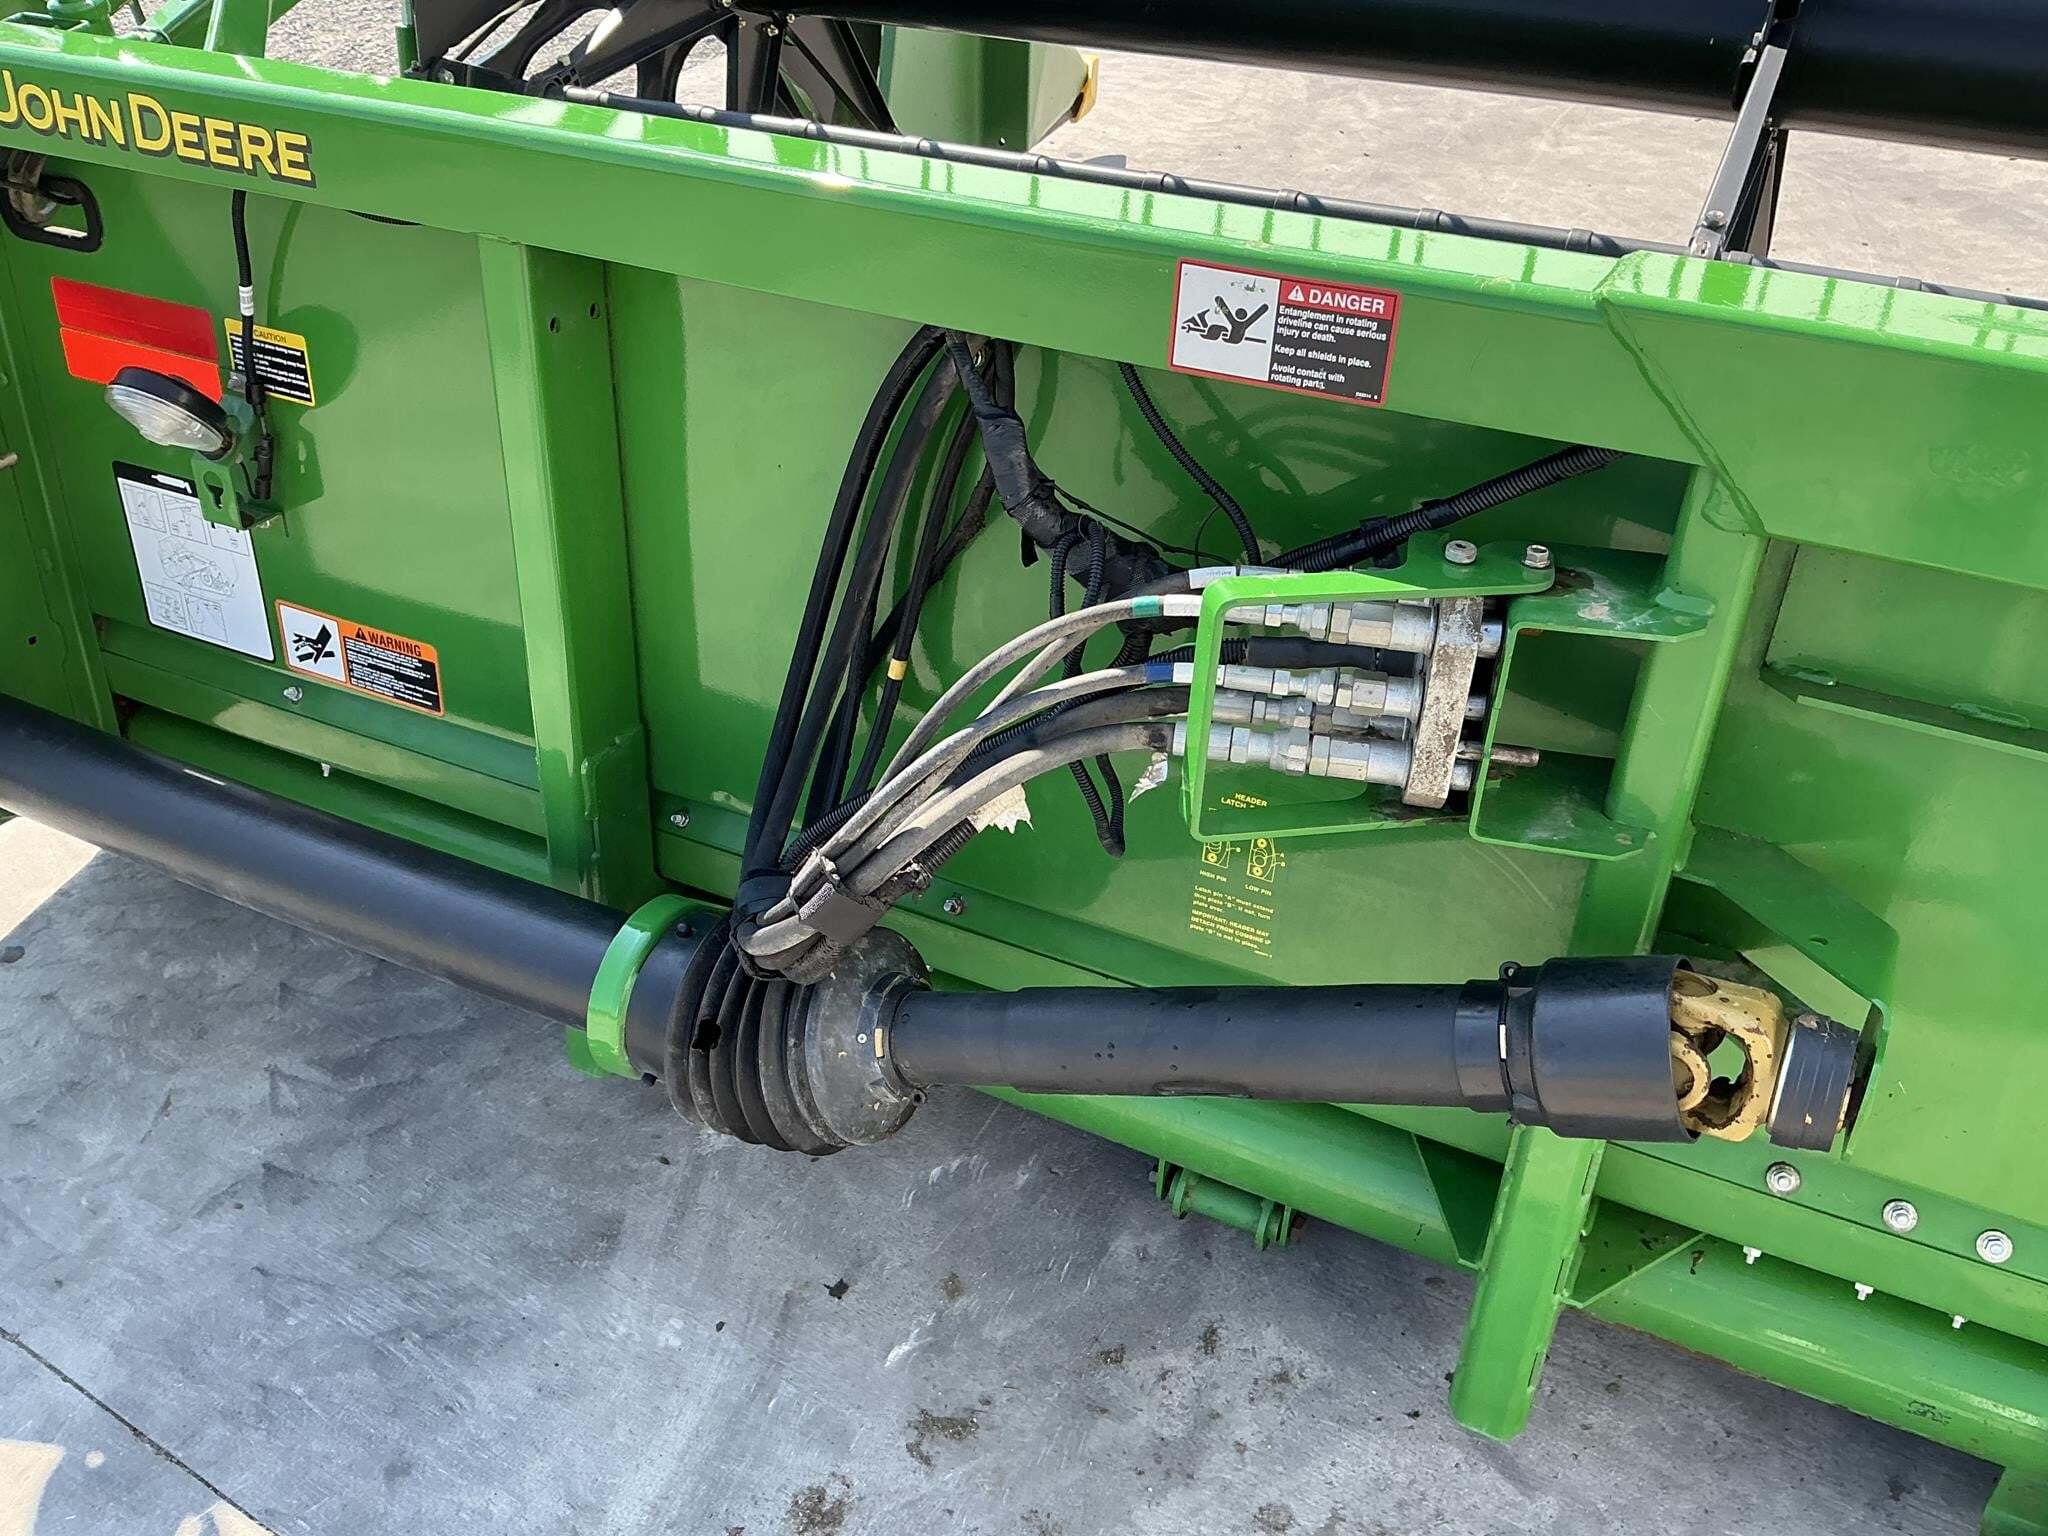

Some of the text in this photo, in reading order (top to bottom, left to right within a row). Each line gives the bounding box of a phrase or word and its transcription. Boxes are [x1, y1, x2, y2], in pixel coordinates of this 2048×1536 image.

[0, 69, 315, 186] JOHN DEERE
[1308, 288, 1385, 314] DANGER
[1277, 315, 1386, 340] driveline can cause serious
[1278, 305, 1377, 330] Entanglement in rotating
[1276, 325, 1336, 342] injury or death.
[1274, 343, 1372, 370] Keep all shields in place.
[1270, 372, 1301, 386] rotating
[1271, 362, 1345, 382] Avoid contact with
[367, 631, 421, 657] WARNING
[1220, 796, 1246, 808] LATCH
[1234, 793, 1267, 806] HEADER
